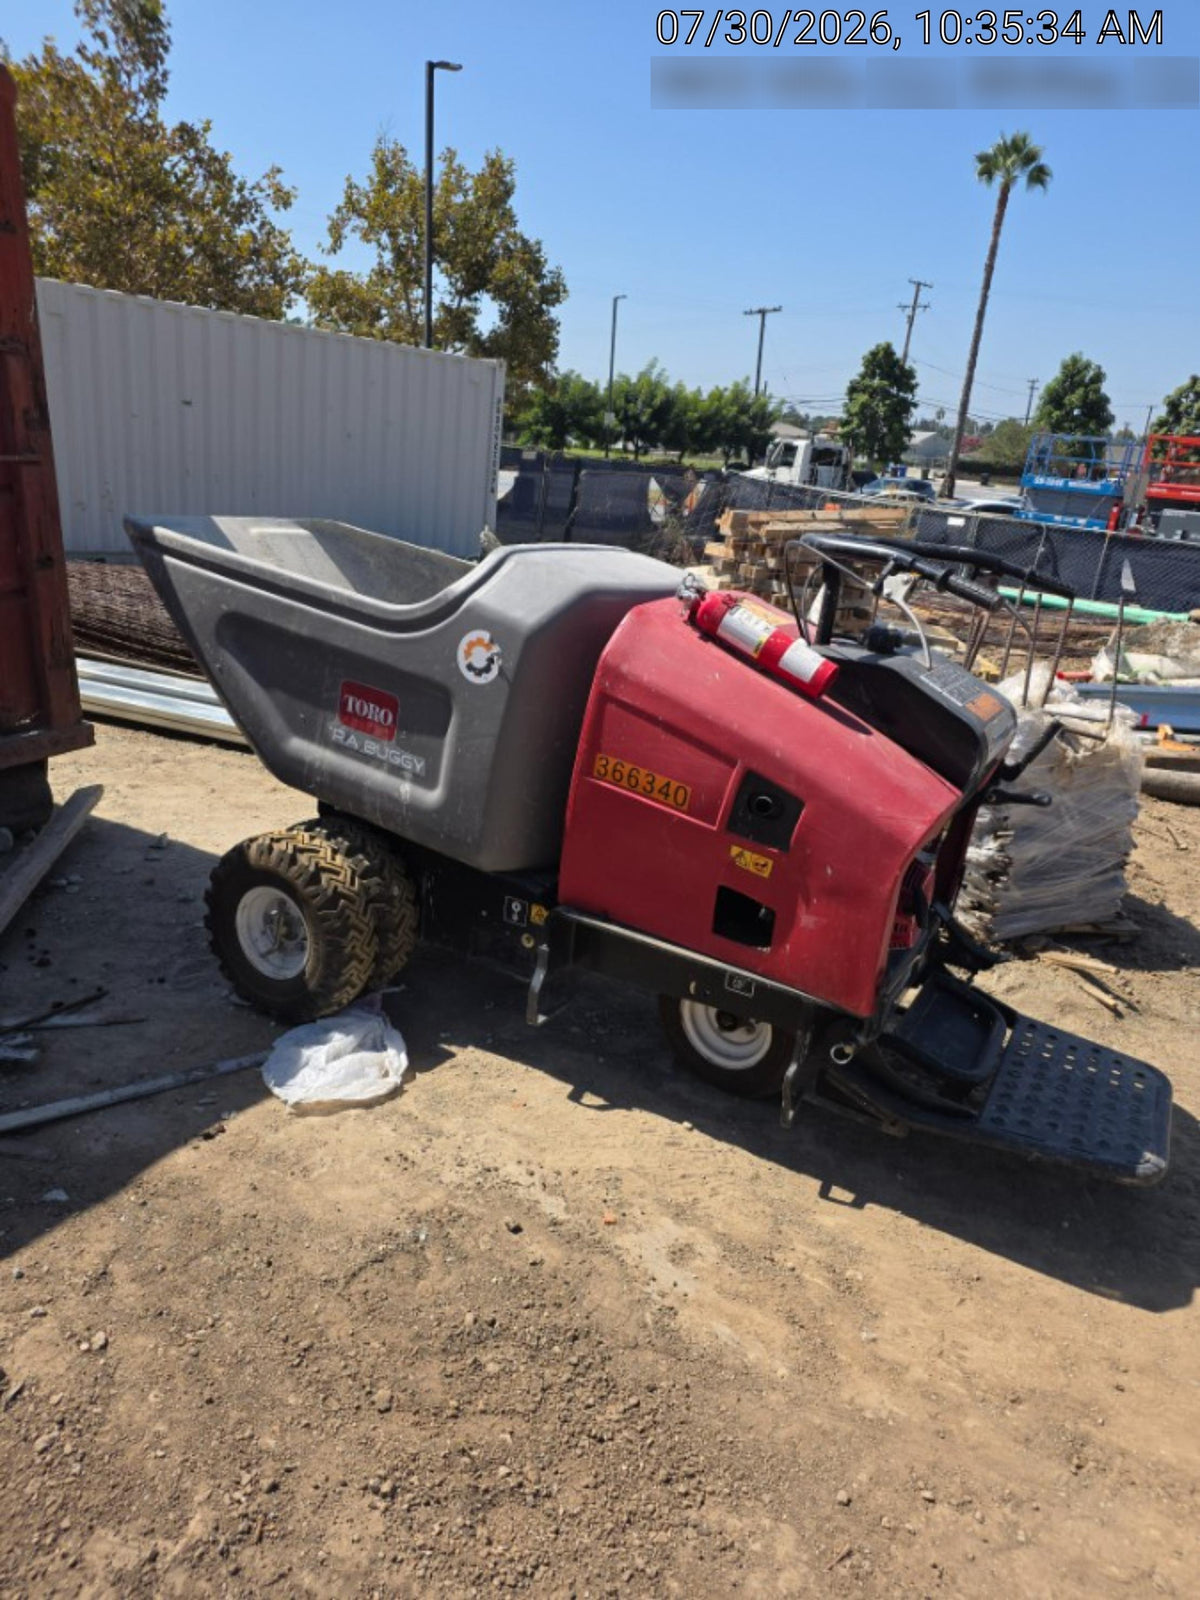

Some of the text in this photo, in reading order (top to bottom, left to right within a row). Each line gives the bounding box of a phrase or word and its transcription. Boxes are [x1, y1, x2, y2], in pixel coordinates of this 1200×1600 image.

[344, 694, 393, 726] TORO
[363, 739, 426, 774] BUGGY
[595, 756, 689, 808] 366340
